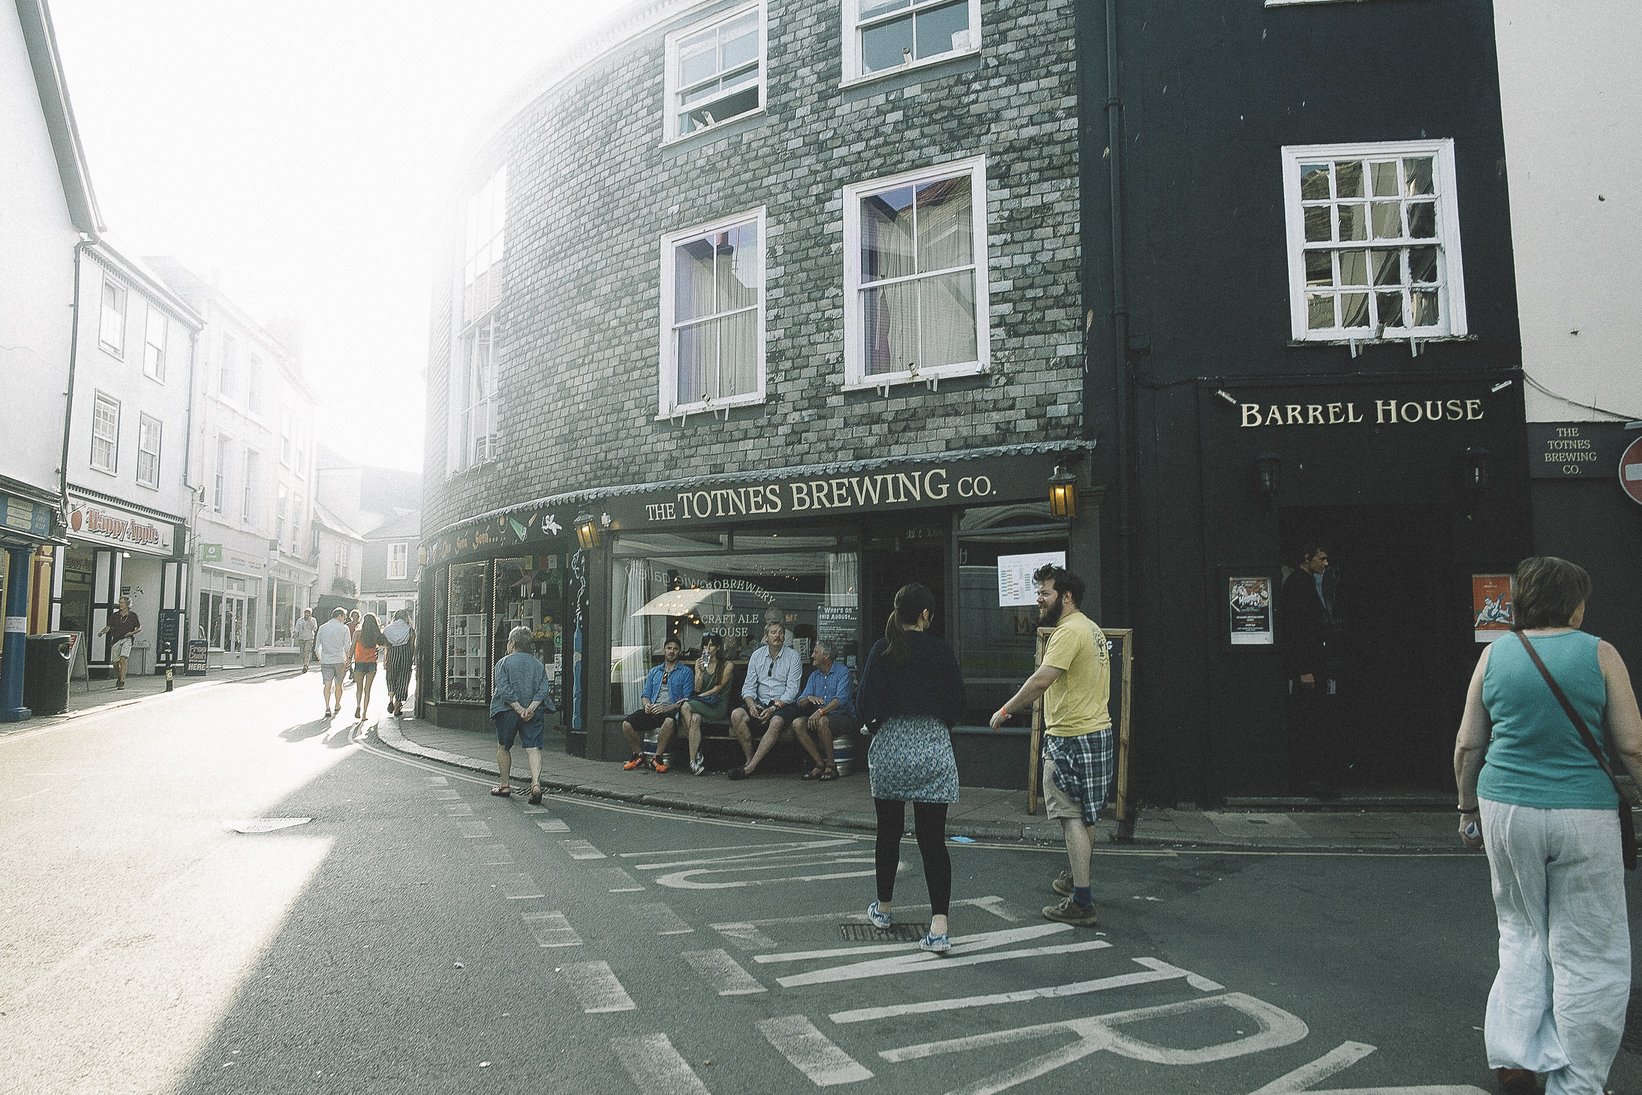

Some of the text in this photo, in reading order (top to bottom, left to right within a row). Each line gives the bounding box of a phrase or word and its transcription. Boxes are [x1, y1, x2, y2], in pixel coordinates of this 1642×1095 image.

[1240, 399, 1484, 428] BARREL HOUSE
[1556, 427, 1579, 437] THE
[1547, 439, 1591, 450] TOTNES
[1544, 451, 1597, 462] BREWING
[1562, 464, 1582, 474] CO.
[645, 468, 997, 521] THE TOTNES BREWING CO.
[88, 507, 159, 545] Happy Apple
[701, 613, 759, 624] CRAFT ALE
[711, 627, 749, 637] HOUSE
[188, 663, 207, 671] HERE
